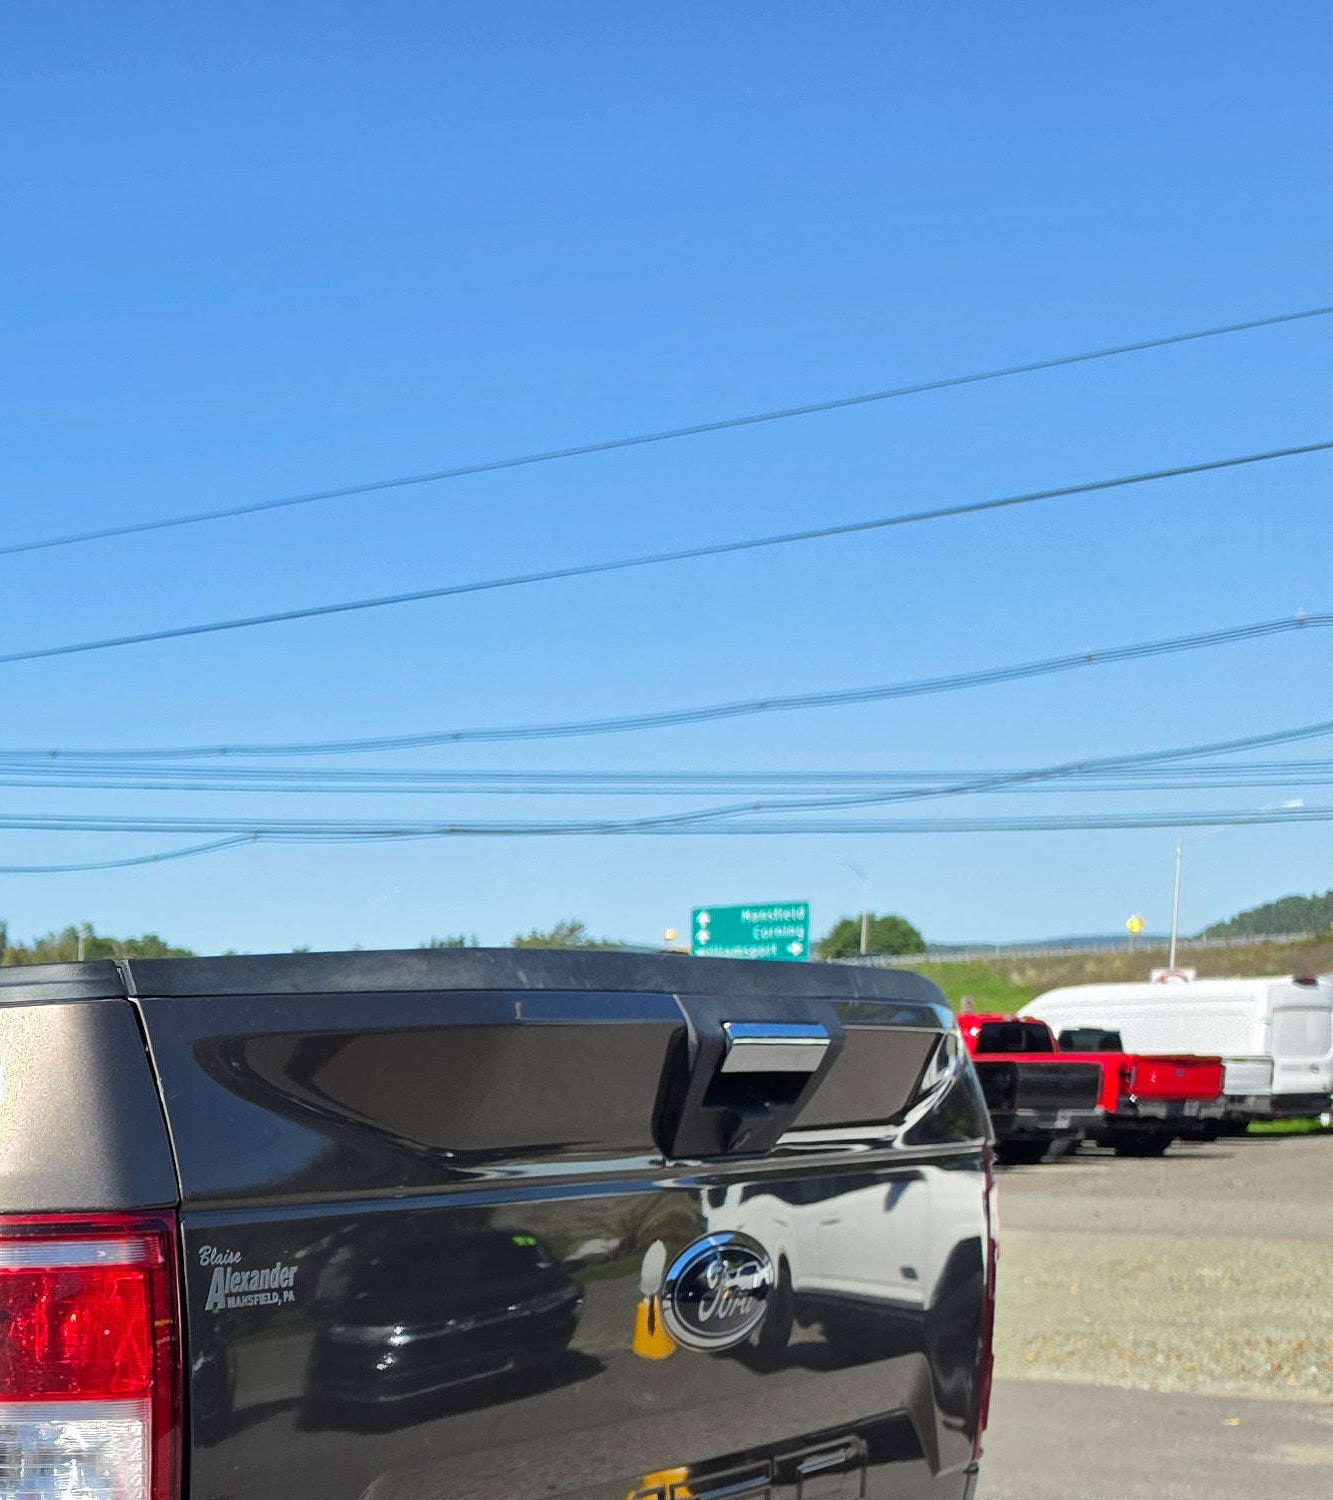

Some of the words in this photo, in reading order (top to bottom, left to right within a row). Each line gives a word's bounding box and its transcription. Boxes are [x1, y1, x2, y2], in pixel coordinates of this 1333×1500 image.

[752, 924, 805, 941] Corning
[198, 1245, 242, 1267] Blaise
[205, 1262, 299, 1311] Alexander
[283, 1290, 296, 1302] PA
